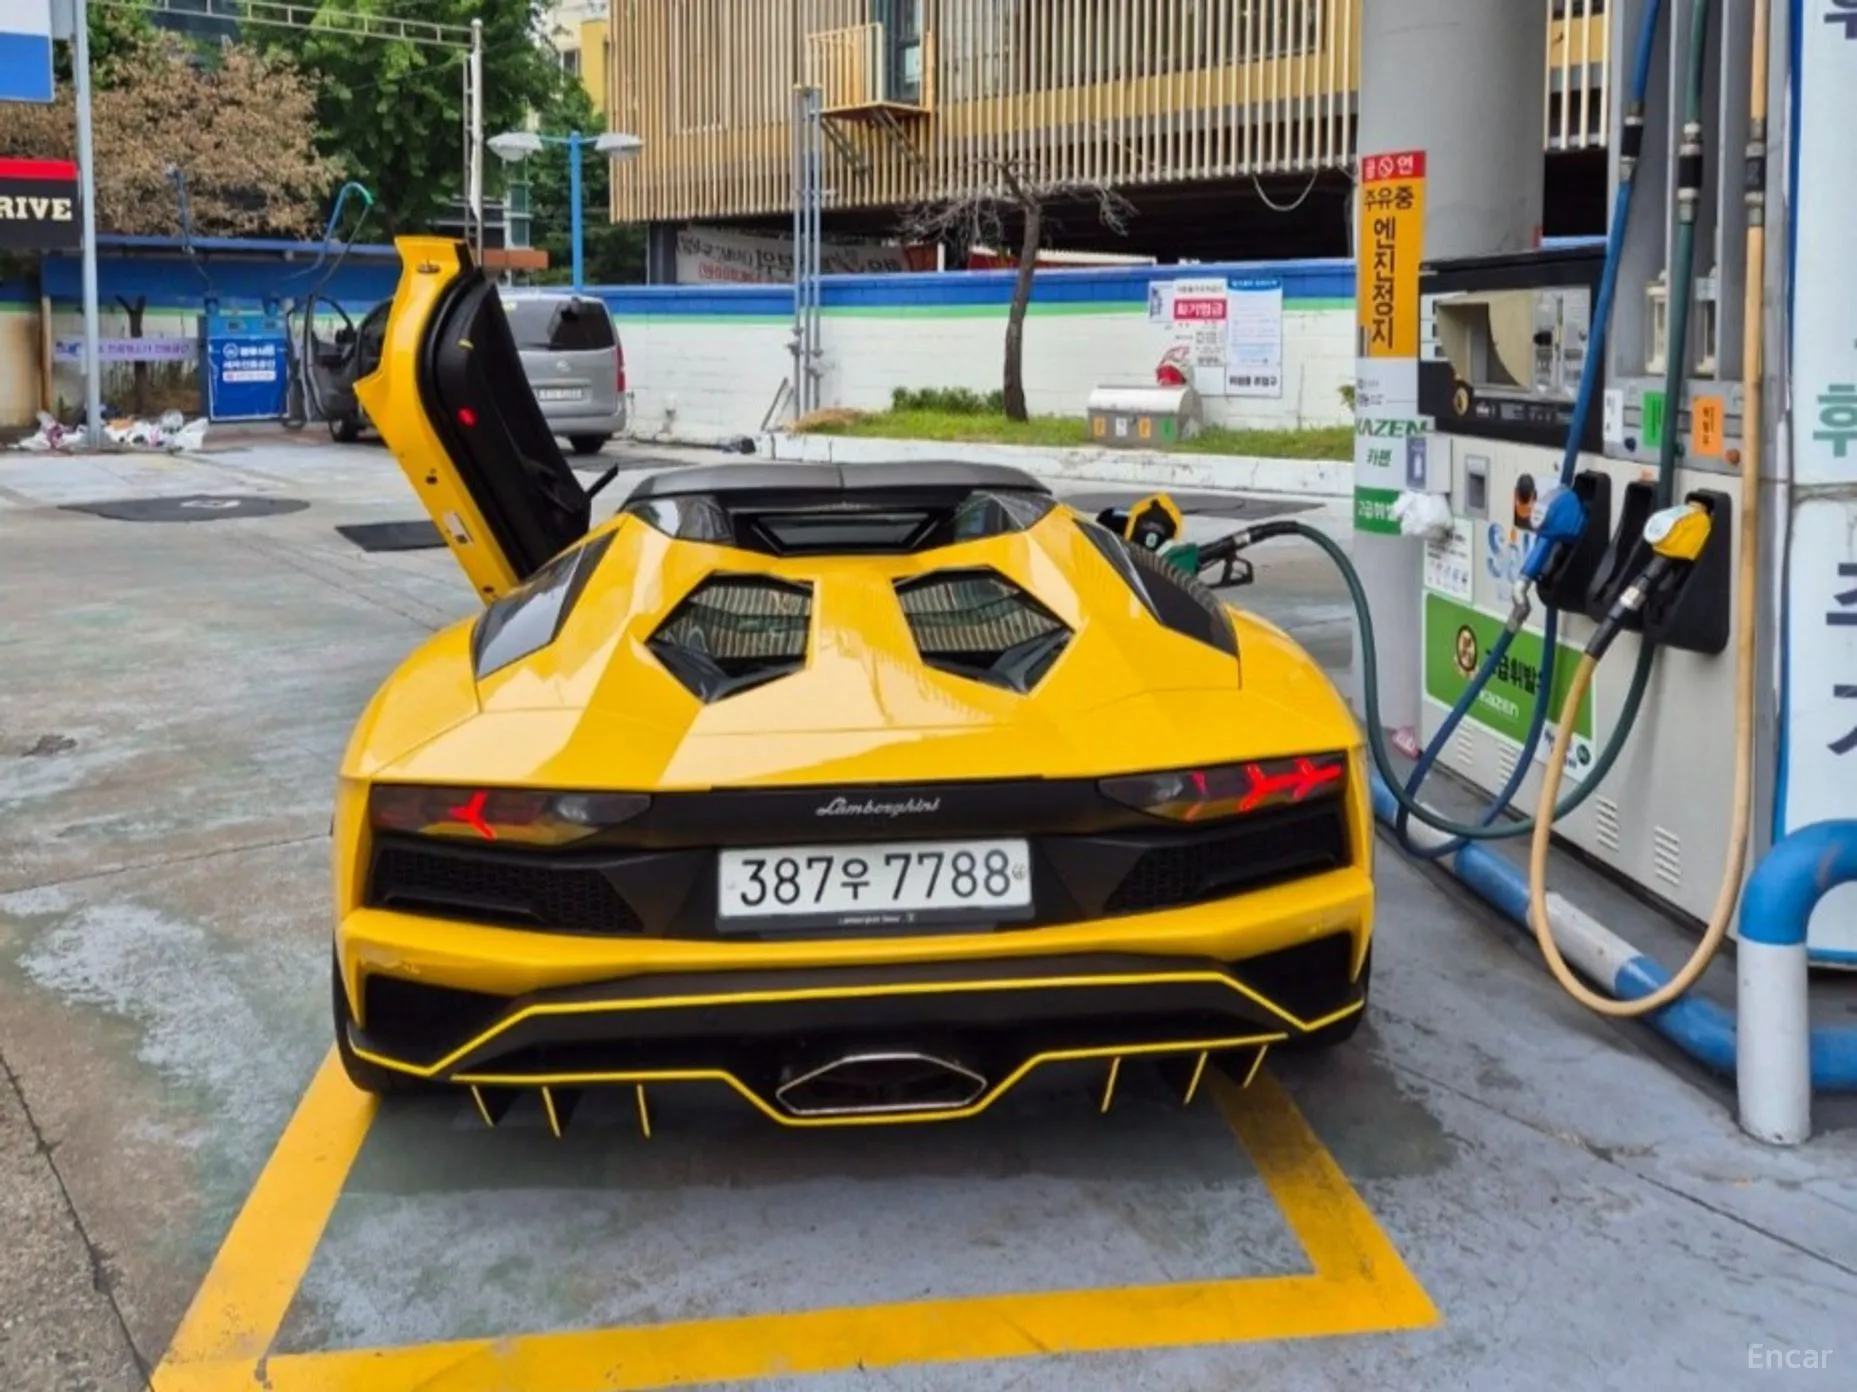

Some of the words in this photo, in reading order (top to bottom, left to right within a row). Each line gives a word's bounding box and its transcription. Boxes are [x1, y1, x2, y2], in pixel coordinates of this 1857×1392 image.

[1363, 185, 1414, 213] 주유중
[1371, 215, 1396, 350] 엔진정지
[815, 796, 941, 818] Lamborghini
